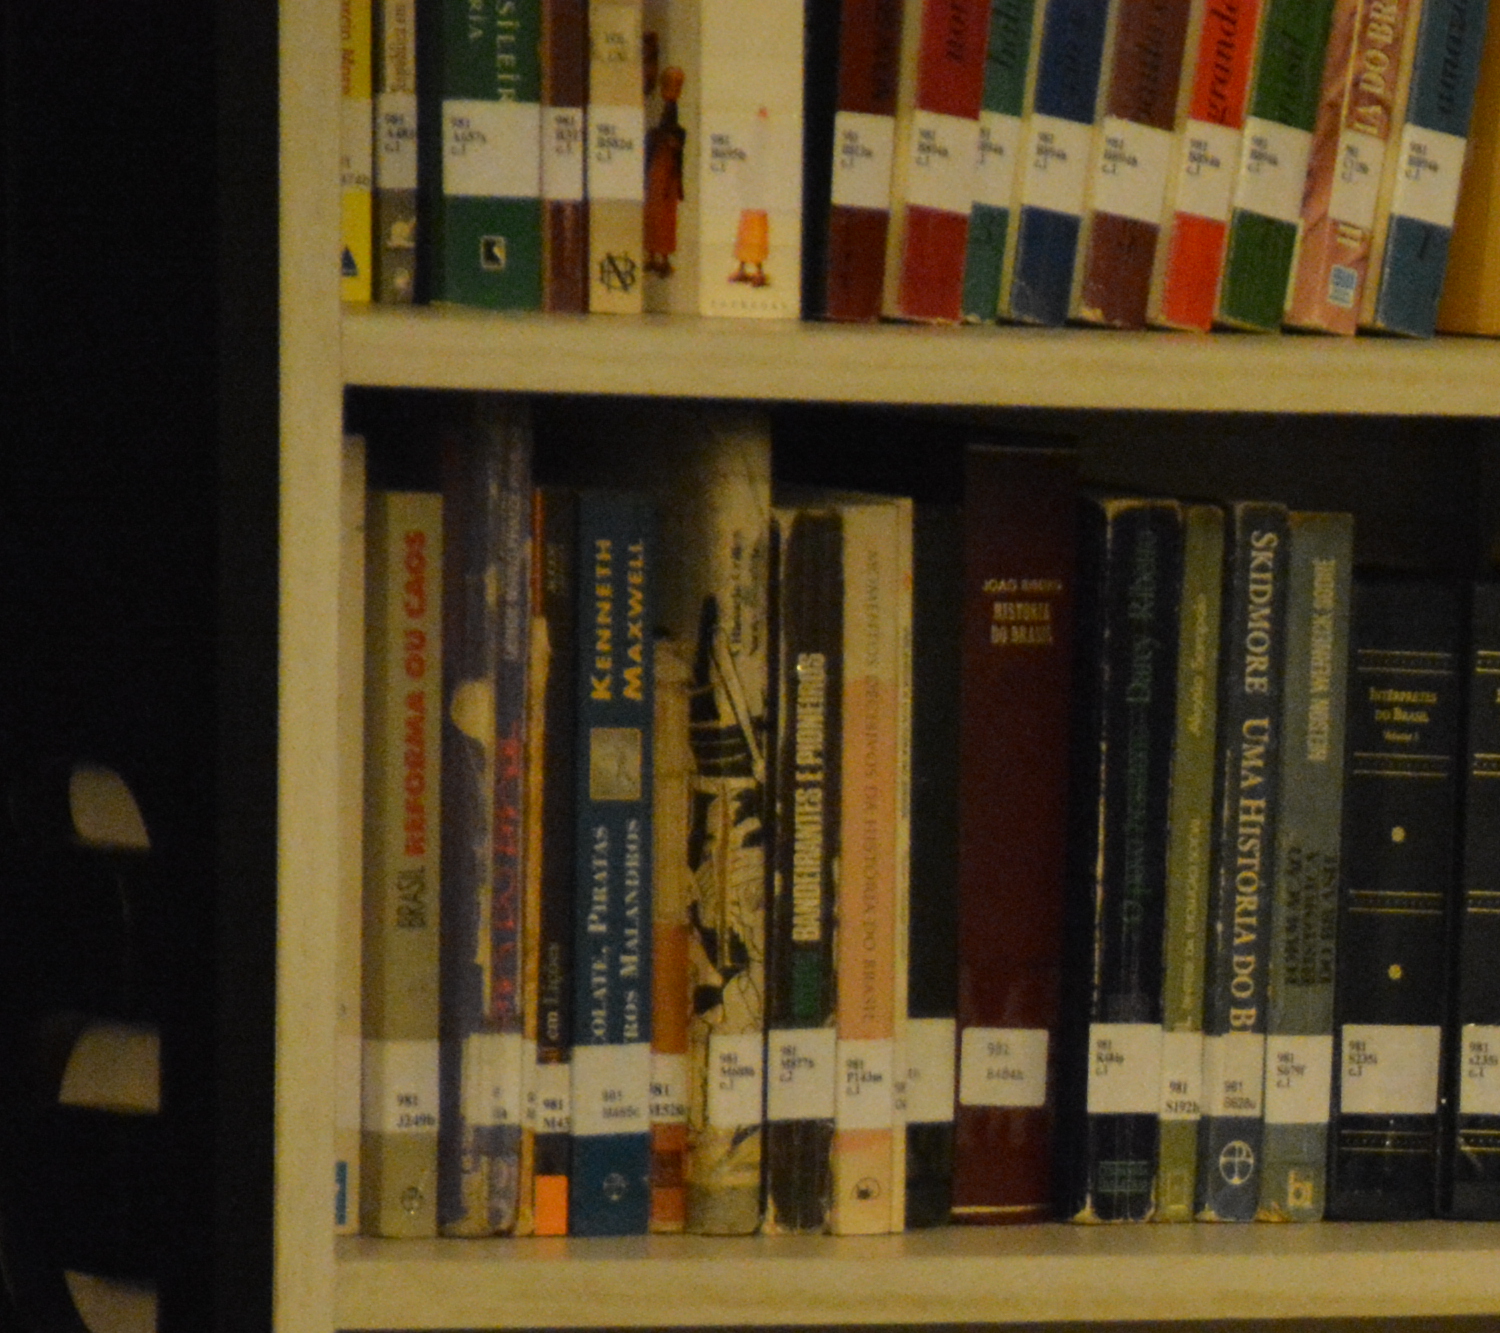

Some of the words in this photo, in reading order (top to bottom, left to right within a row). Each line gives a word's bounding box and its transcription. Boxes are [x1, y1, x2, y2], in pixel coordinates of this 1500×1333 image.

[403, 529, 426, 620] CAOS
[589, 538, 613, 702] KENNETH
[621, 538, 644, 702] MAXWELL
[864, 551, 880, 667] MOMENTOS
[1243, 530, 1278, 695] SKIDMORE
[404, 627, 427, 680] OU
[1309, 613, 1334, 694] WERNECK
[796, 652, 827, 767] PIONEIROS
[863, 673, 880, 778] DECISIVOS
[1239, 716, 1271, 790] UMA
[1306, 697, 1331, 763] NELSON
[404, 690, 427, 858] REFORMA
[795, 771, 824, 783] E
[587, 824, 610, 935] PIRATAS
[619, 817, 642, 978] MALANDROS
[790, 787, 825, 943] BANDEIRANTES
[1232, 797, 1267, 946] HISTÓRIA
[860, 956, 878, 1023] BRASIL
[861, 920, 878, 951] DO
[1231, 953, 1257, 1000] DO
